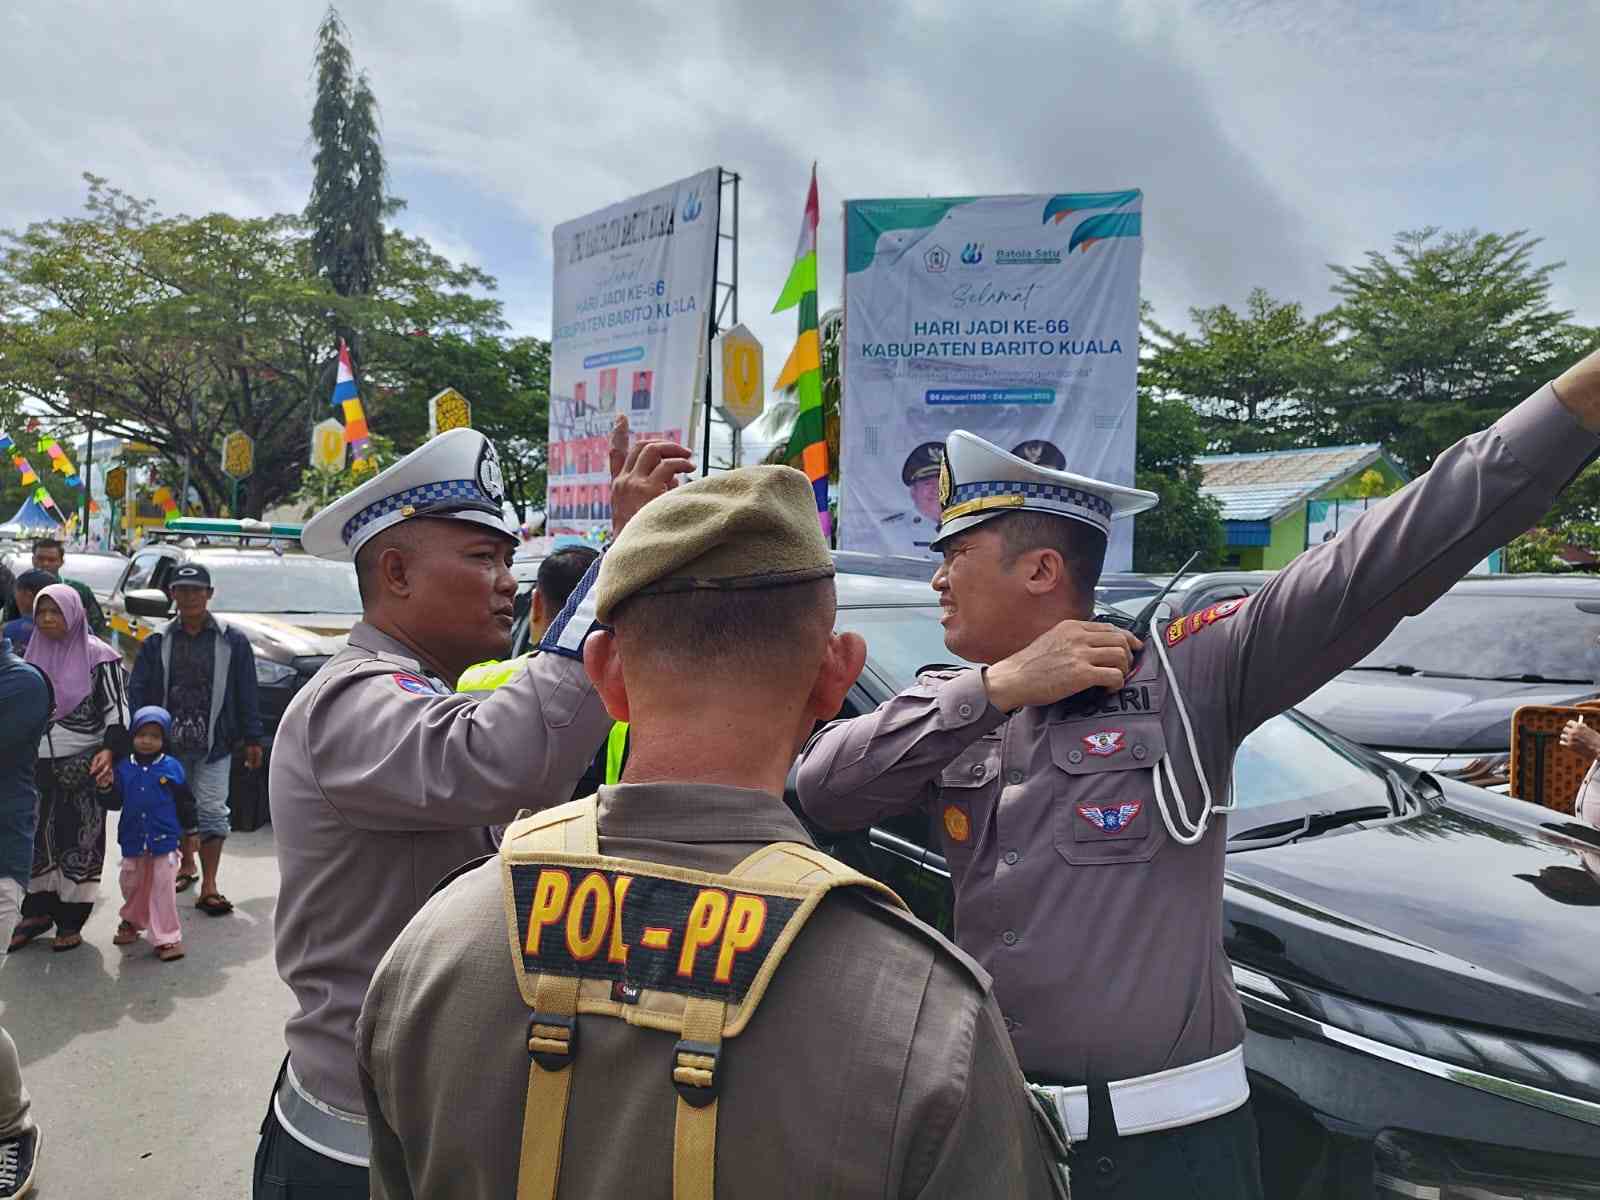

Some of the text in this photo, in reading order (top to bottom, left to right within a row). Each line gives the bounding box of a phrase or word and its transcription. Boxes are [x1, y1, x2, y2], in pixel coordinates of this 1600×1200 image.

[628, 280, 665, 300] KE-66
[951, 281, 1046, 311] Selamat
[607, 304, 652, 328] BARITO
[914, 319, 1069, 336] HARI JADI KE-66
[862, 339, 1122, 357] KABUPATEN BARITO KUALA
[1064, 686, 1150, 718] LRI
